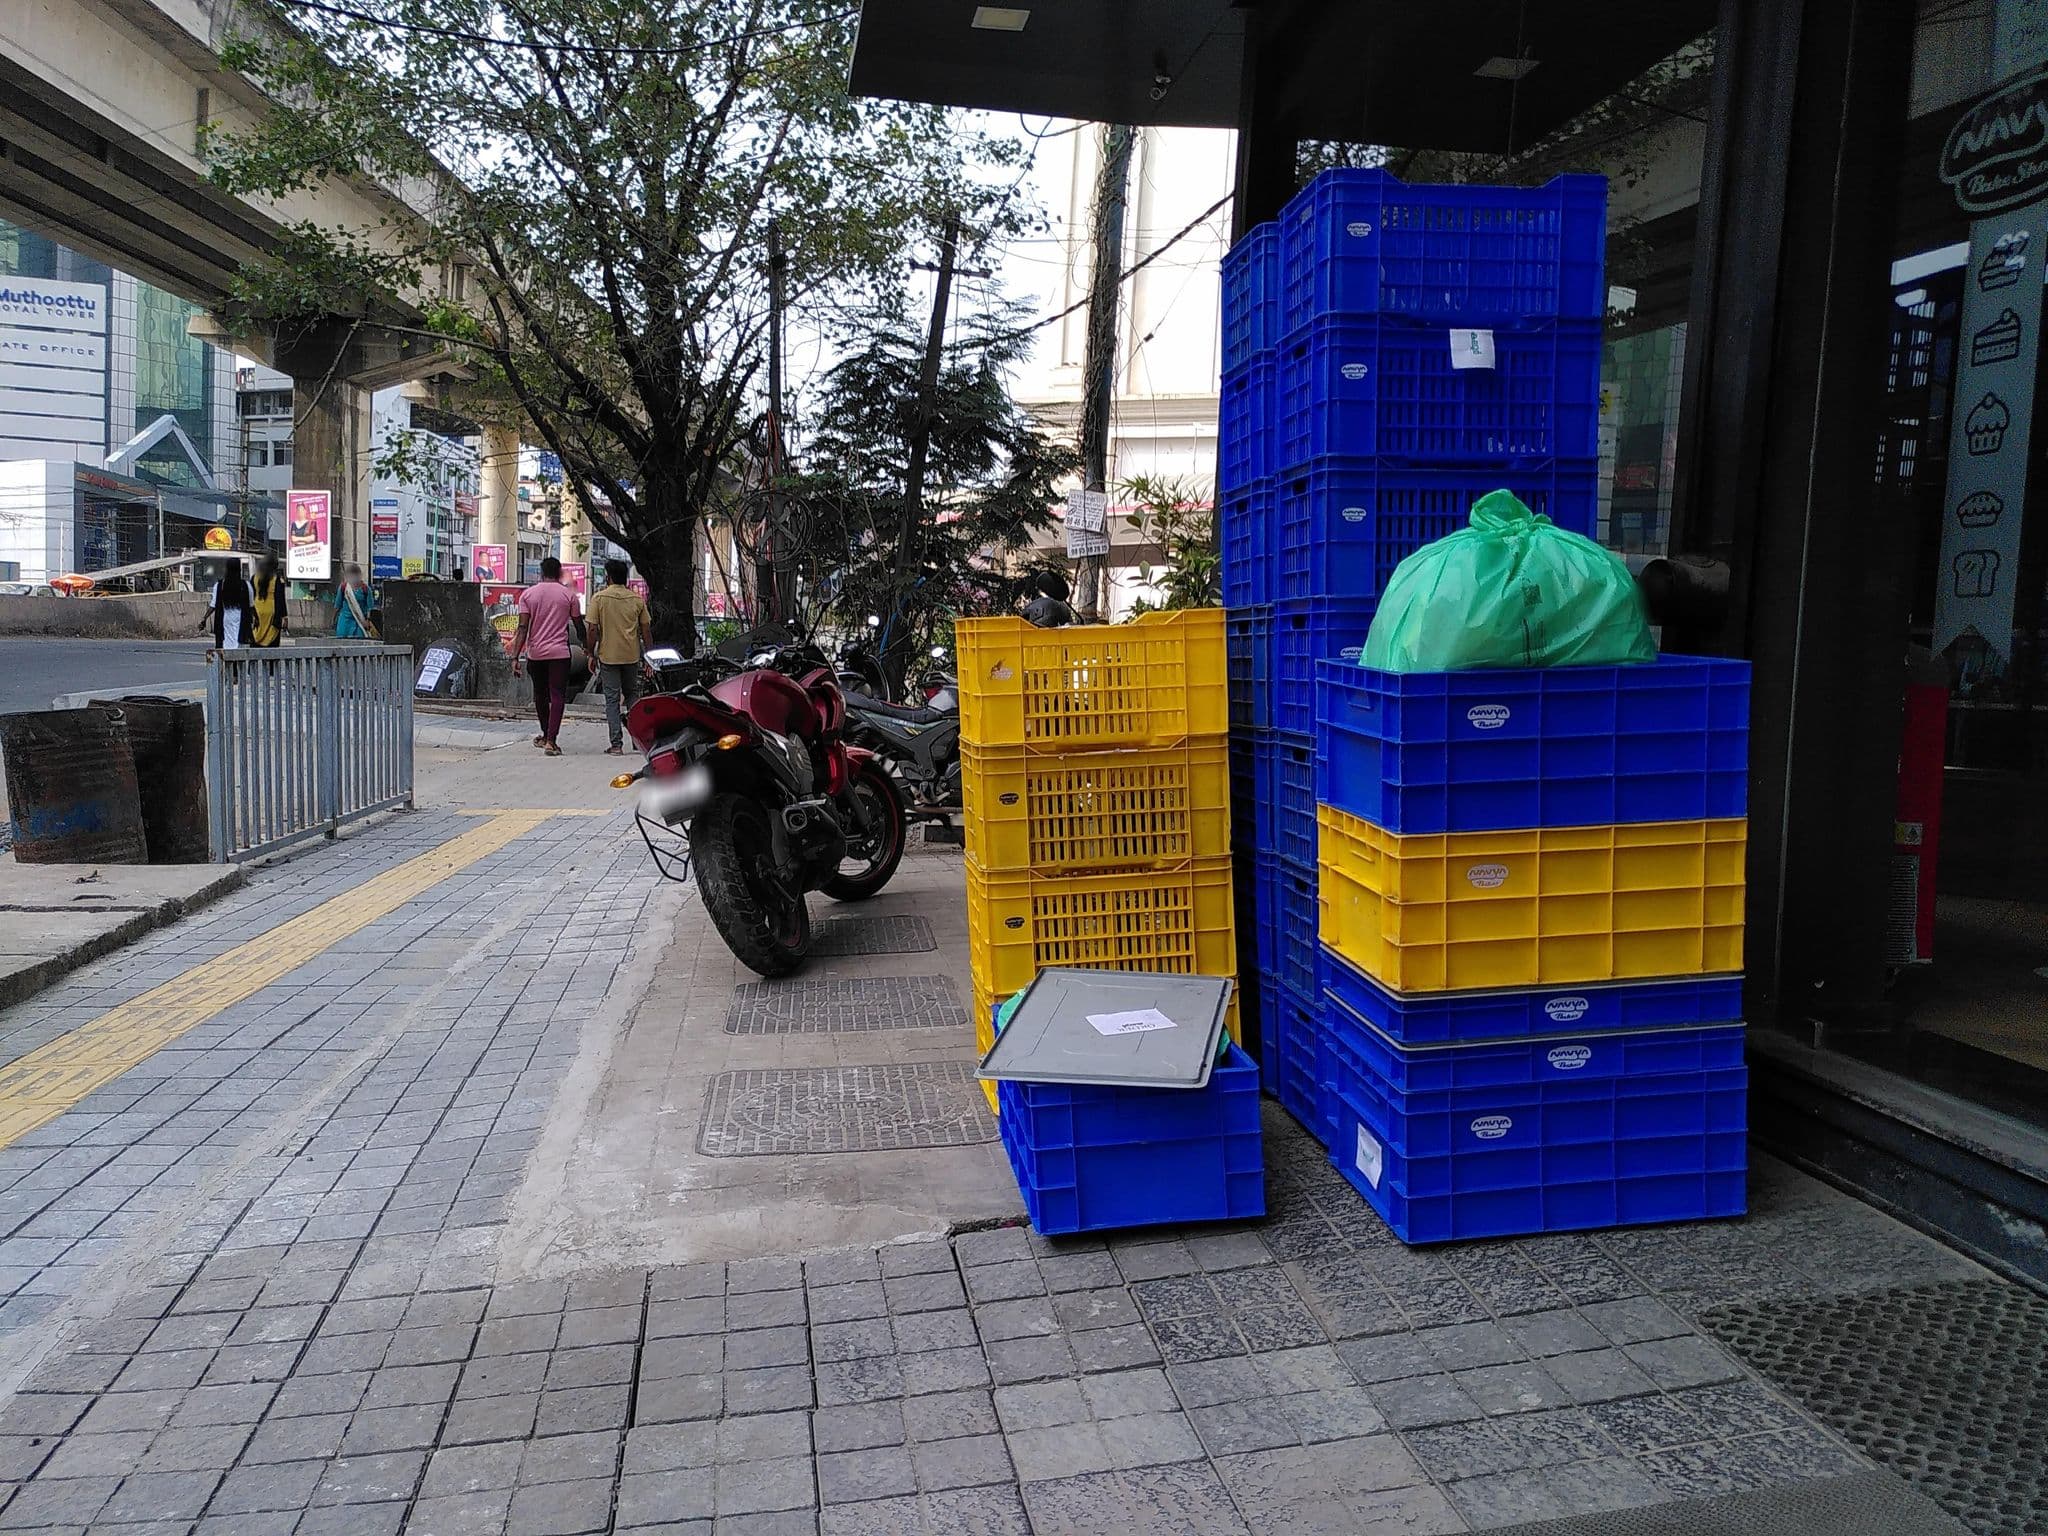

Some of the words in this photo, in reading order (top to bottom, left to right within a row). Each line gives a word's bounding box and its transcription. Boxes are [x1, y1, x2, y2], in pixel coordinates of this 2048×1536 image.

[2, 304, 39, 314] OYAL
[46, 308, 95, 320] TOWER
[40, 345, 96, 357] OFFICE
[1469, 707, 1509, 719] NAVYA
[1546, 1000, 1586, 1010] NAVYA
[1549, 1049, 1589, 1059] NAVYA
[1472, 1118, 1509, 1130] NAVYA
